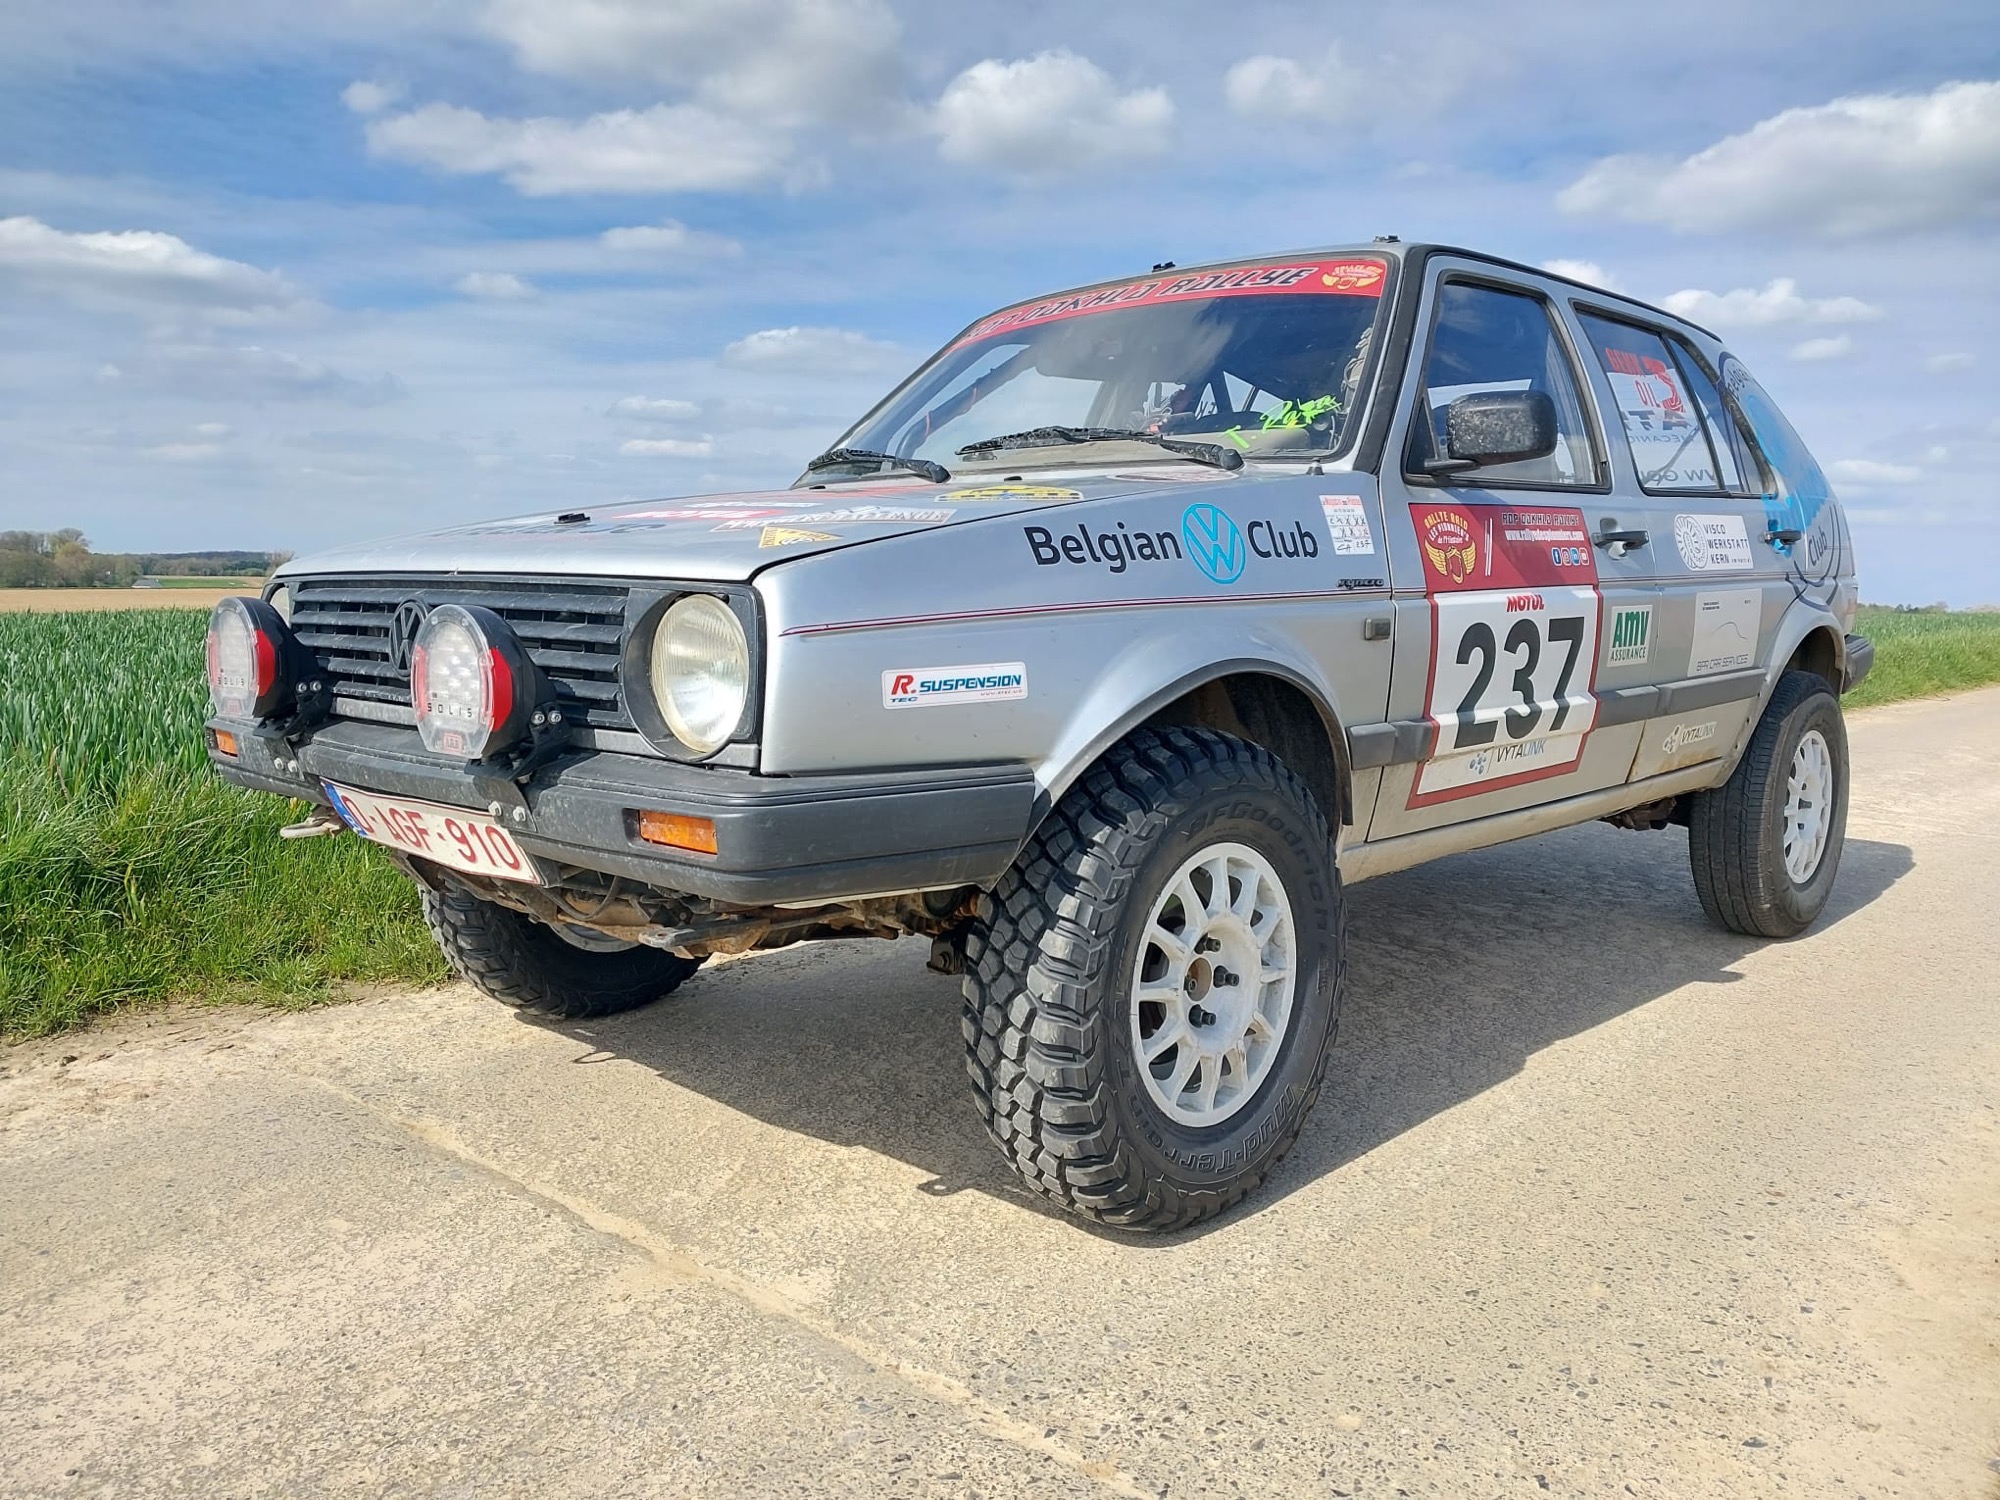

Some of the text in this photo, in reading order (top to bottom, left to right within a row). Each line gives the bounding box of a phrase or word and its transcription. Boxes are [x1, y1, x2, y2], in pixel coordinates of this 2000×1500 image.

[1155, 266, 1319, 297] RALLYE
[1635, 380, 1661, 408] OIL
[1424, 511, 1449, 530] RALLYE
[1703, 523, 1726, 534] VISCO
[1023, 522, 1182, 574] Belgian
[1247, 520, 1319, 559] Club
[1707, 538, 1750, 550] WERKSTATT
[1808, 525, 1827, 567] Club
[1711, 553, 1729, 564] KERN
[1506, 594, 1545, 613] MOTUL
[1610, 646, 1647, 662] ASSURANCE
[919, 674, 1022, 693] SUSPENSION
[1454, 616, 1585, 749] 237
[427, 702, 473, 718] SOLIS
[1497, 739, 1546, 763] VYTALINK
